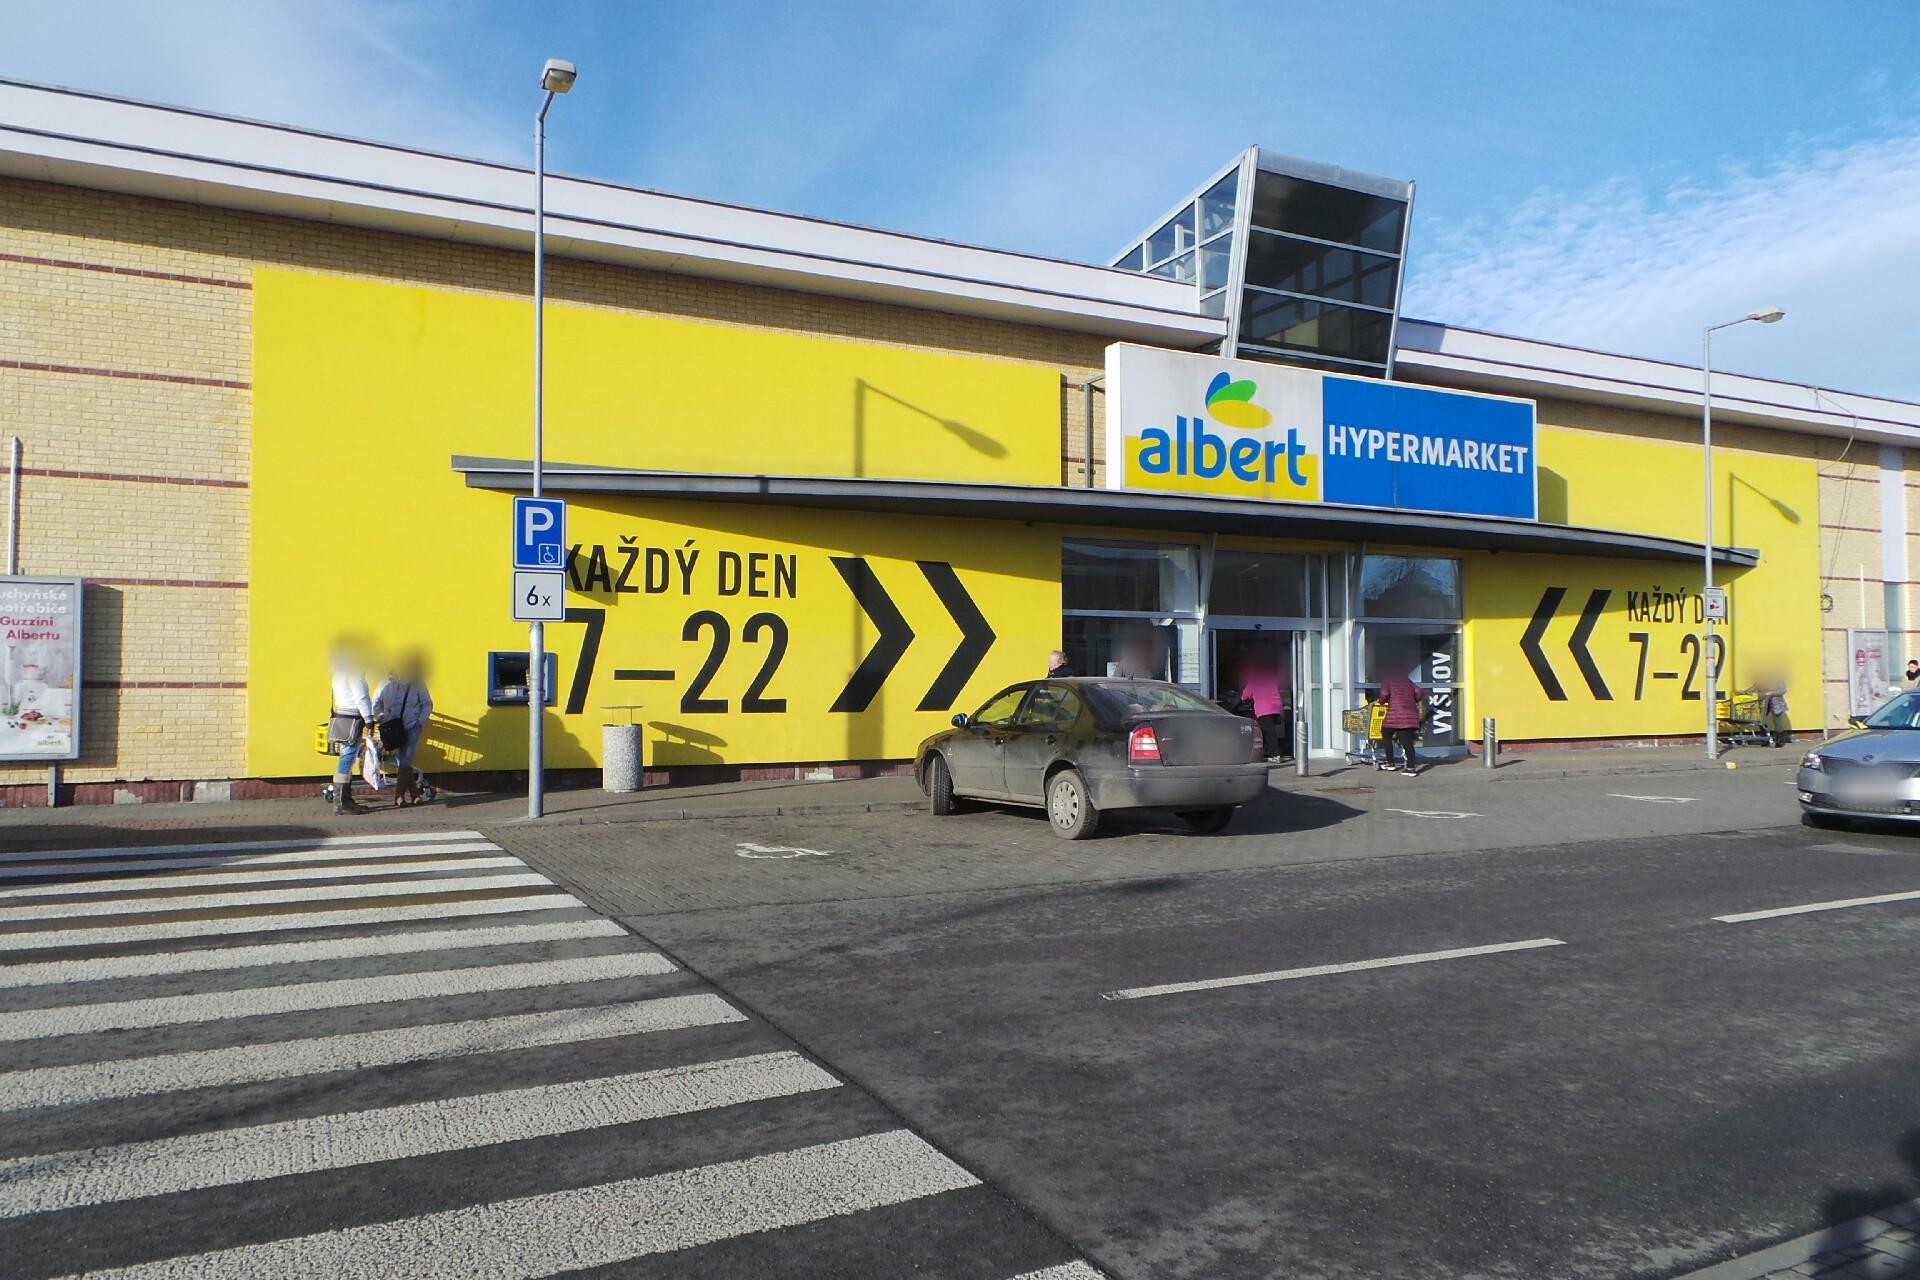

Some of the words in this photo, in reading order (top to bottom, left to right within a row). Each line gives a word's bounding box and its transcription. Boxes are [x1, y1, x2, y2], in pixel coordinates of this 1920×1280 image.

[1138, 415, 1309, 487] albert
[1328, 424, 1529, 475] HYPERMARKET
[524, 506, 554, 546] P
[567, 535, 700, 595] KAŽDÝ
[717, 550, 797, 599] DEN
[0, 616, 54, 627] Guzzini
[1627, 585, 1688, 624] KAŽDÝ
[6, 629, 60, 641] Albertu
